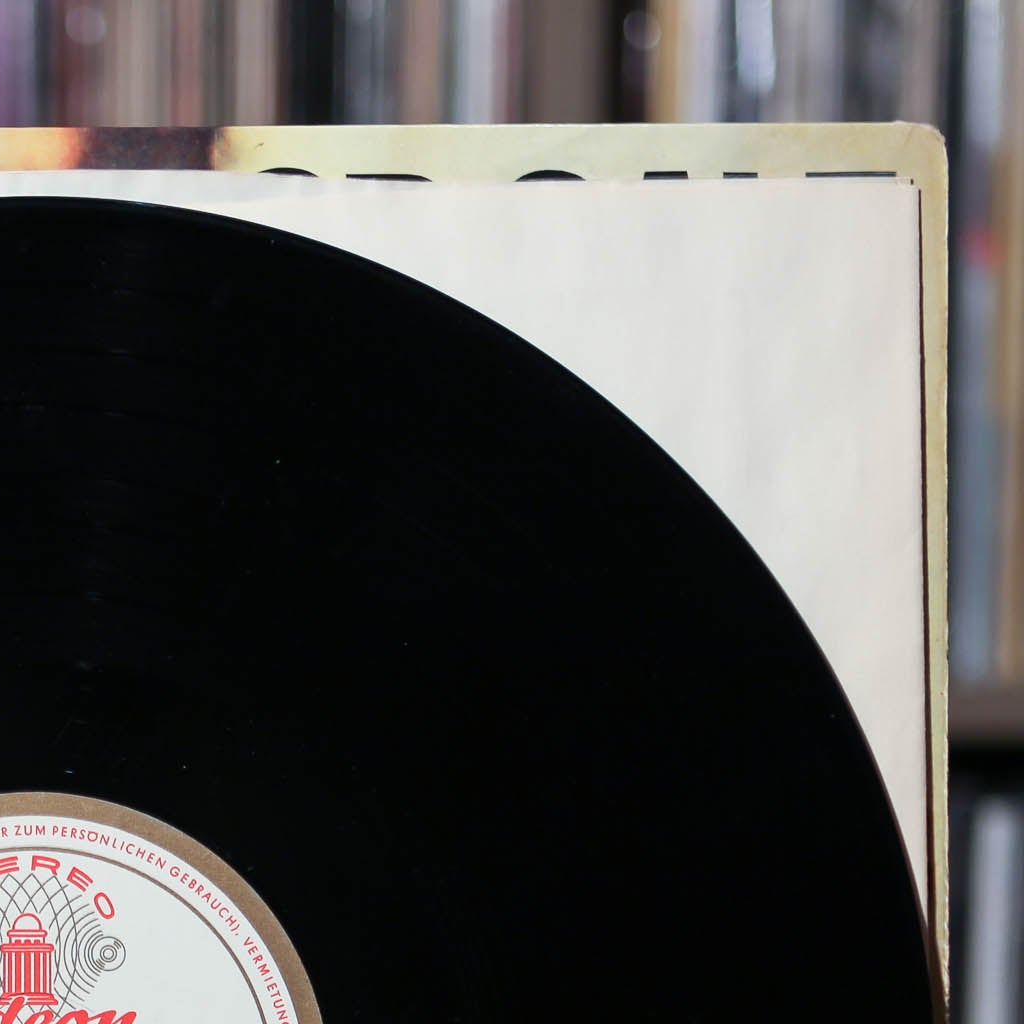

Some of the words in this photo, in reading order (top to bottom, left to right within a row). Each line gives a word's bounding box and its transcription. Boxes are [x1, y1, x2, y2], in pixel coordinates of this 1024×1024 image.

[14, 825, 45, 836] ZUM
[52, 826, 166, 869] PERSÖNLICHEN
[170, 866, 240, 936] GEBRAUCH),
